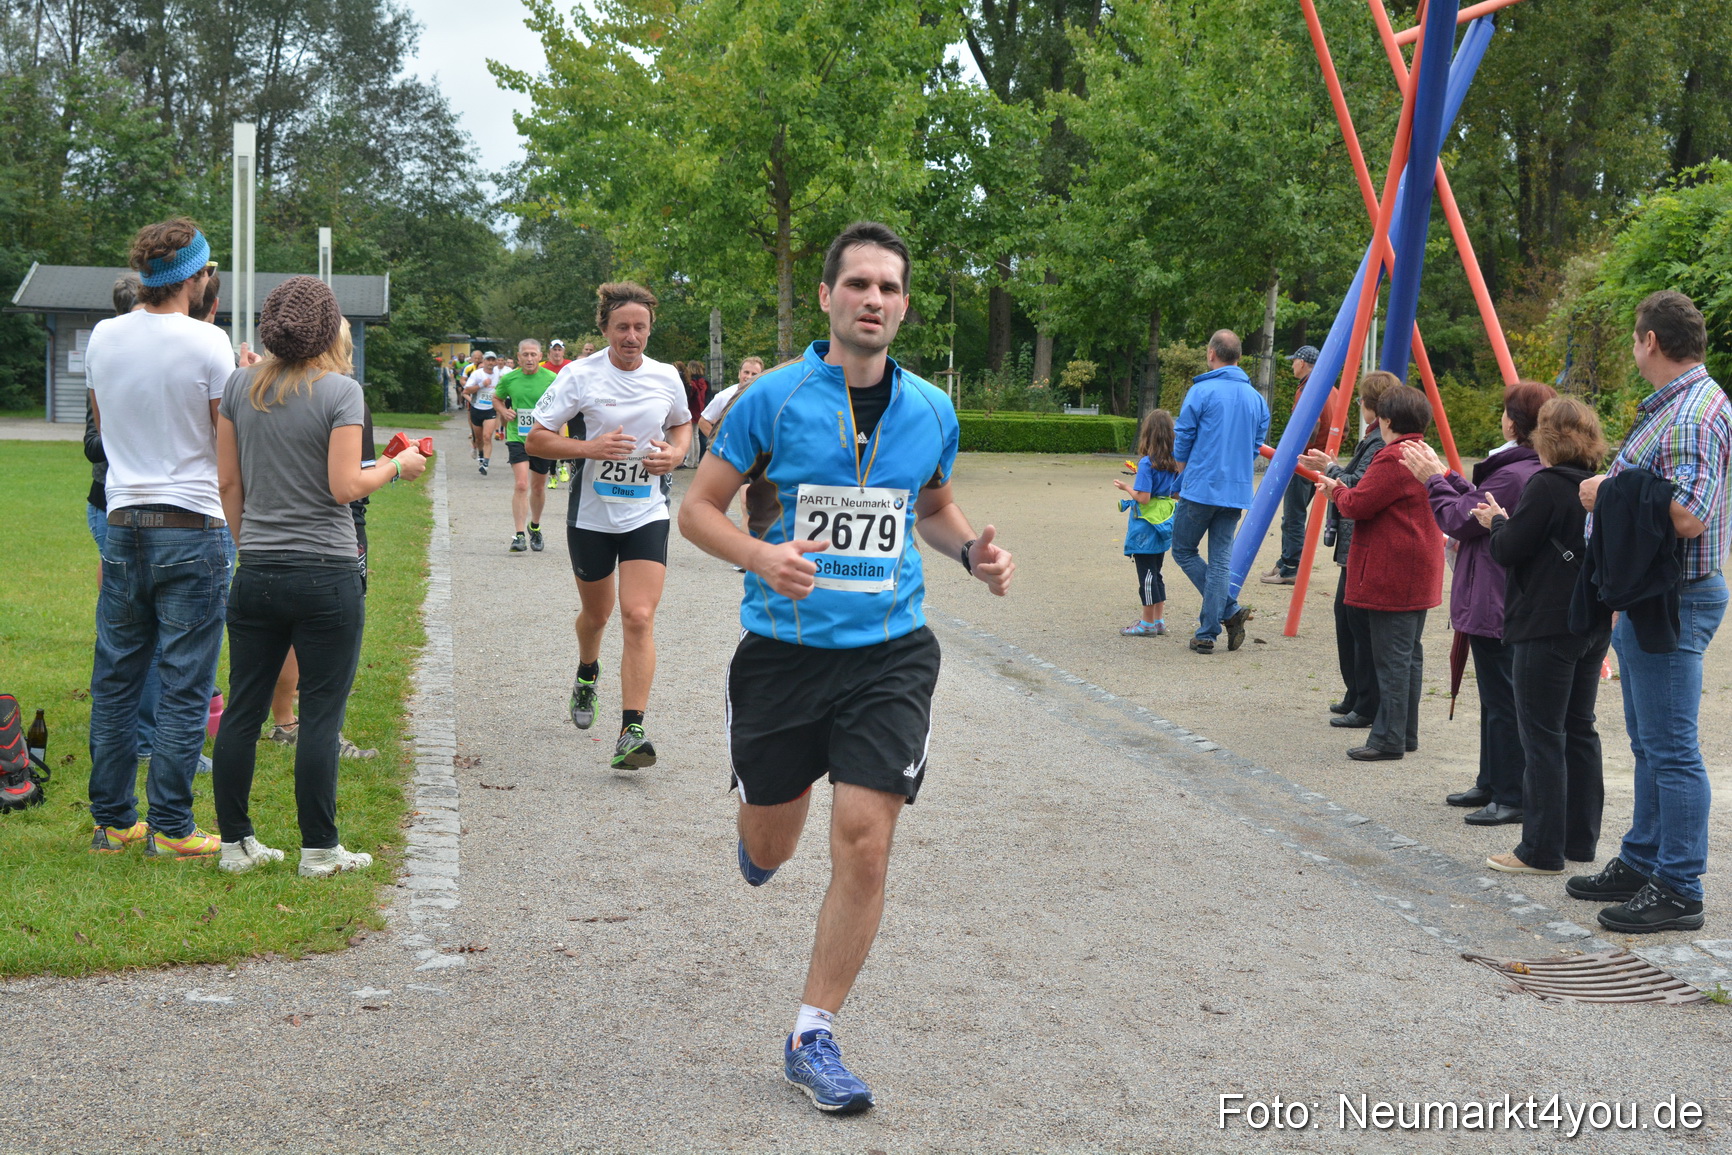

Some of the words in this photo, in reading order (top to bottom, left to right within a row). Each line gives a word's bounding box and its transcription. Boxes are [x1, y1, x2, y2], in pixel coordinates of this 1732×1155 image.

[600, 460, 650, 483] 2514
[611, 486, 635, 497] Claus
[799, 494, 838, 506] PARTL
[841, 497, 891, 509] Neumarkt
[123, 512, 164, 527] PMA
[807, 510, 897, 552] 2679
[814, 558, 885, 578] Sebastian
